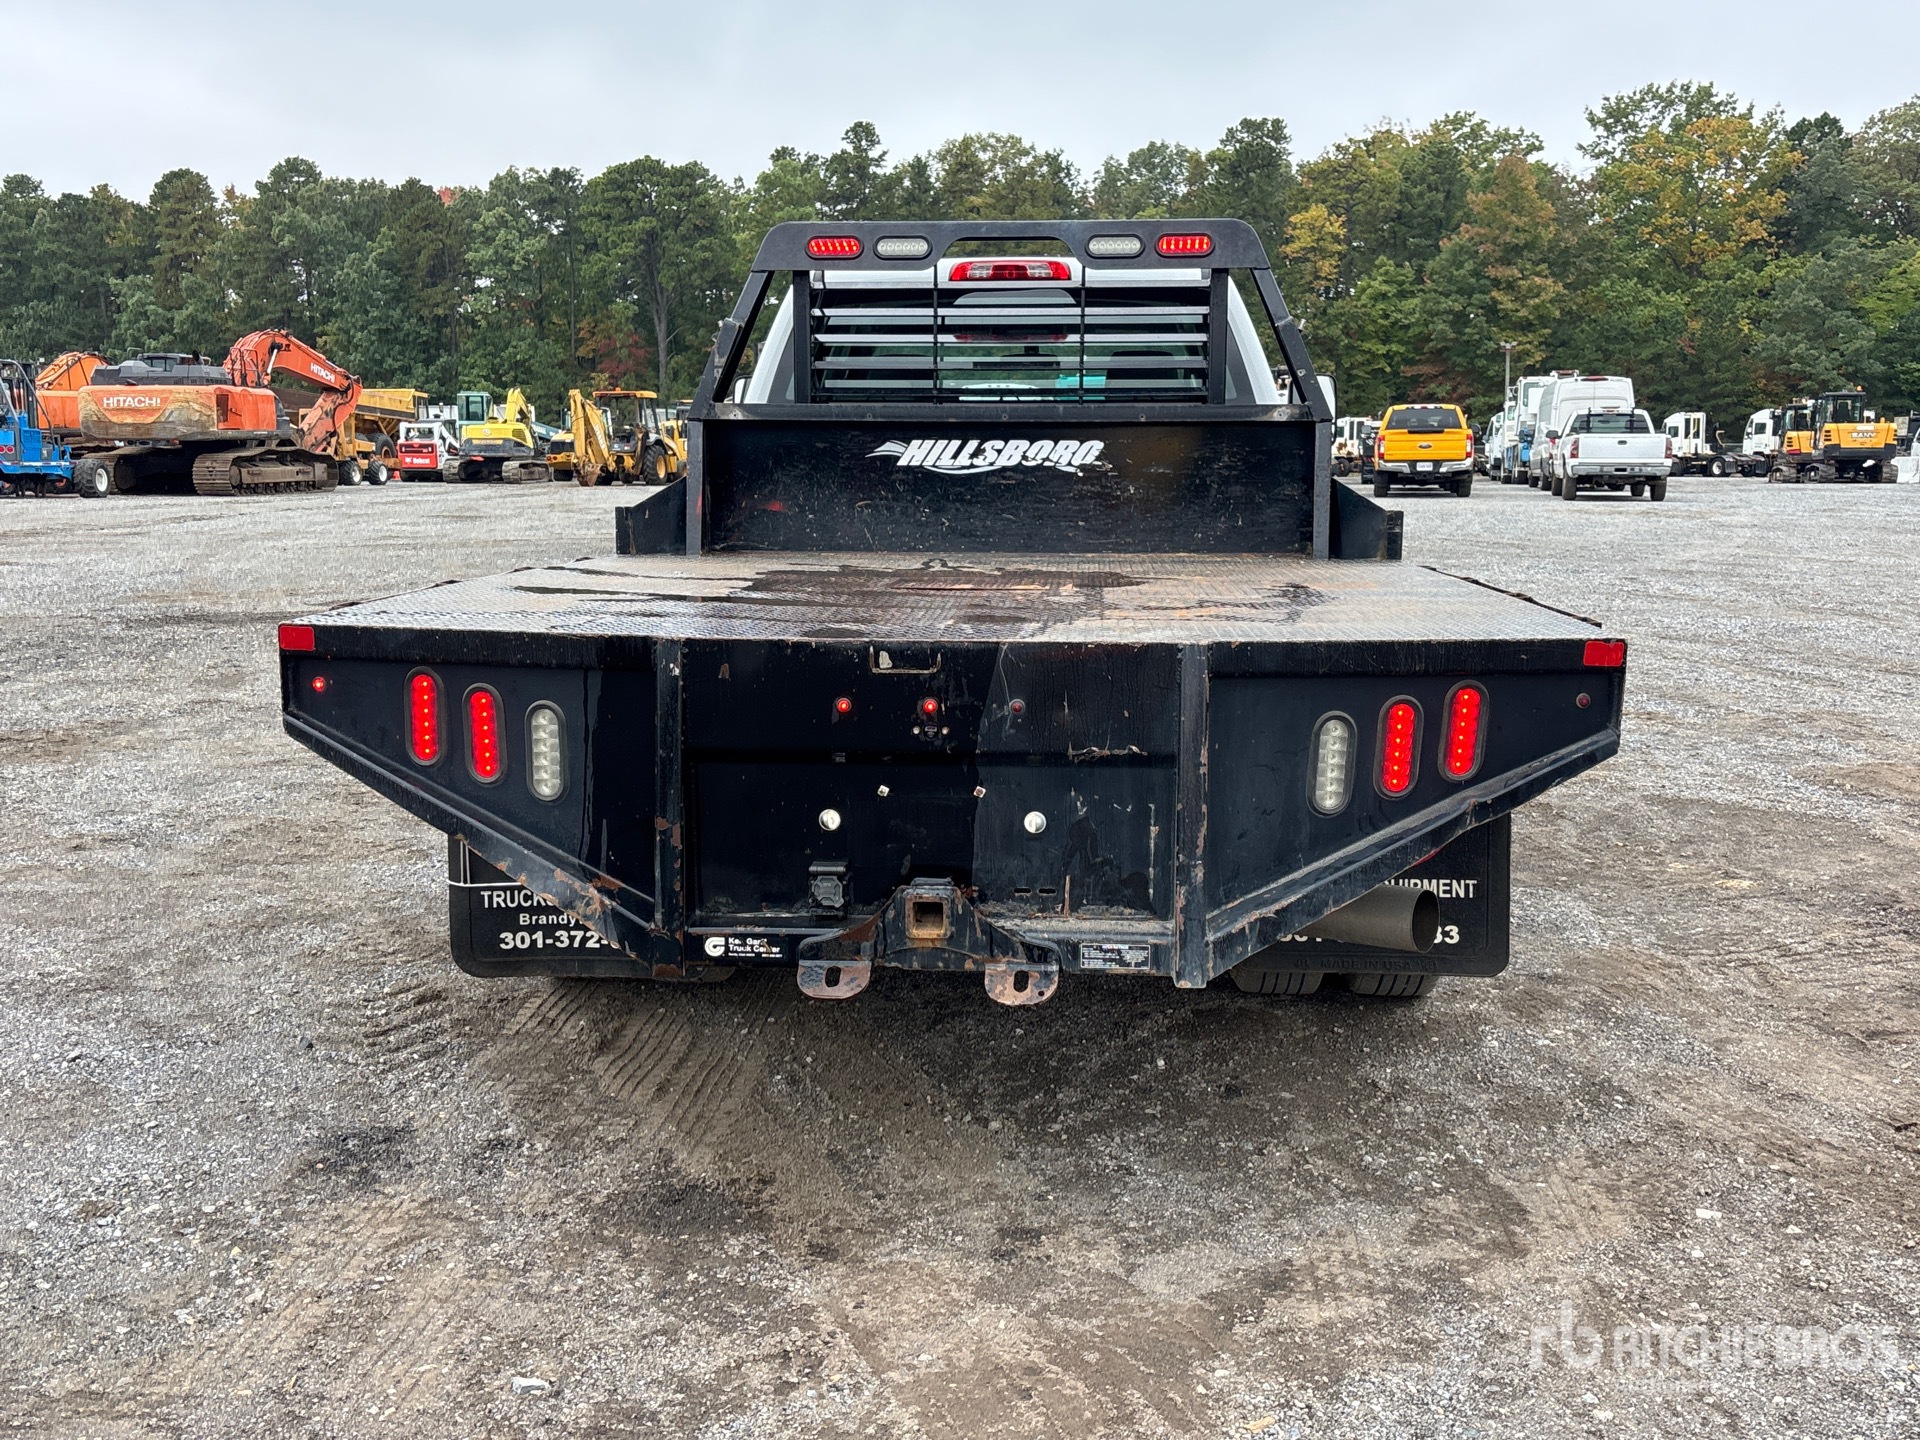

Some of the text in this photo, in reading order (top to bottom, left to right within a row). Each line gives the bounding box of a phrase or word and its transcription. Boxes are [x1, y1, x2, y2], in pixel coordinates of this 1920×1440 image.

[310, 362, 335, 383] HITACHI
[103, 396, 160, 408] HITACHI
[897, 440, 1105, 466] HILLSBORO
[519, 912, 583, 927] Brandy
